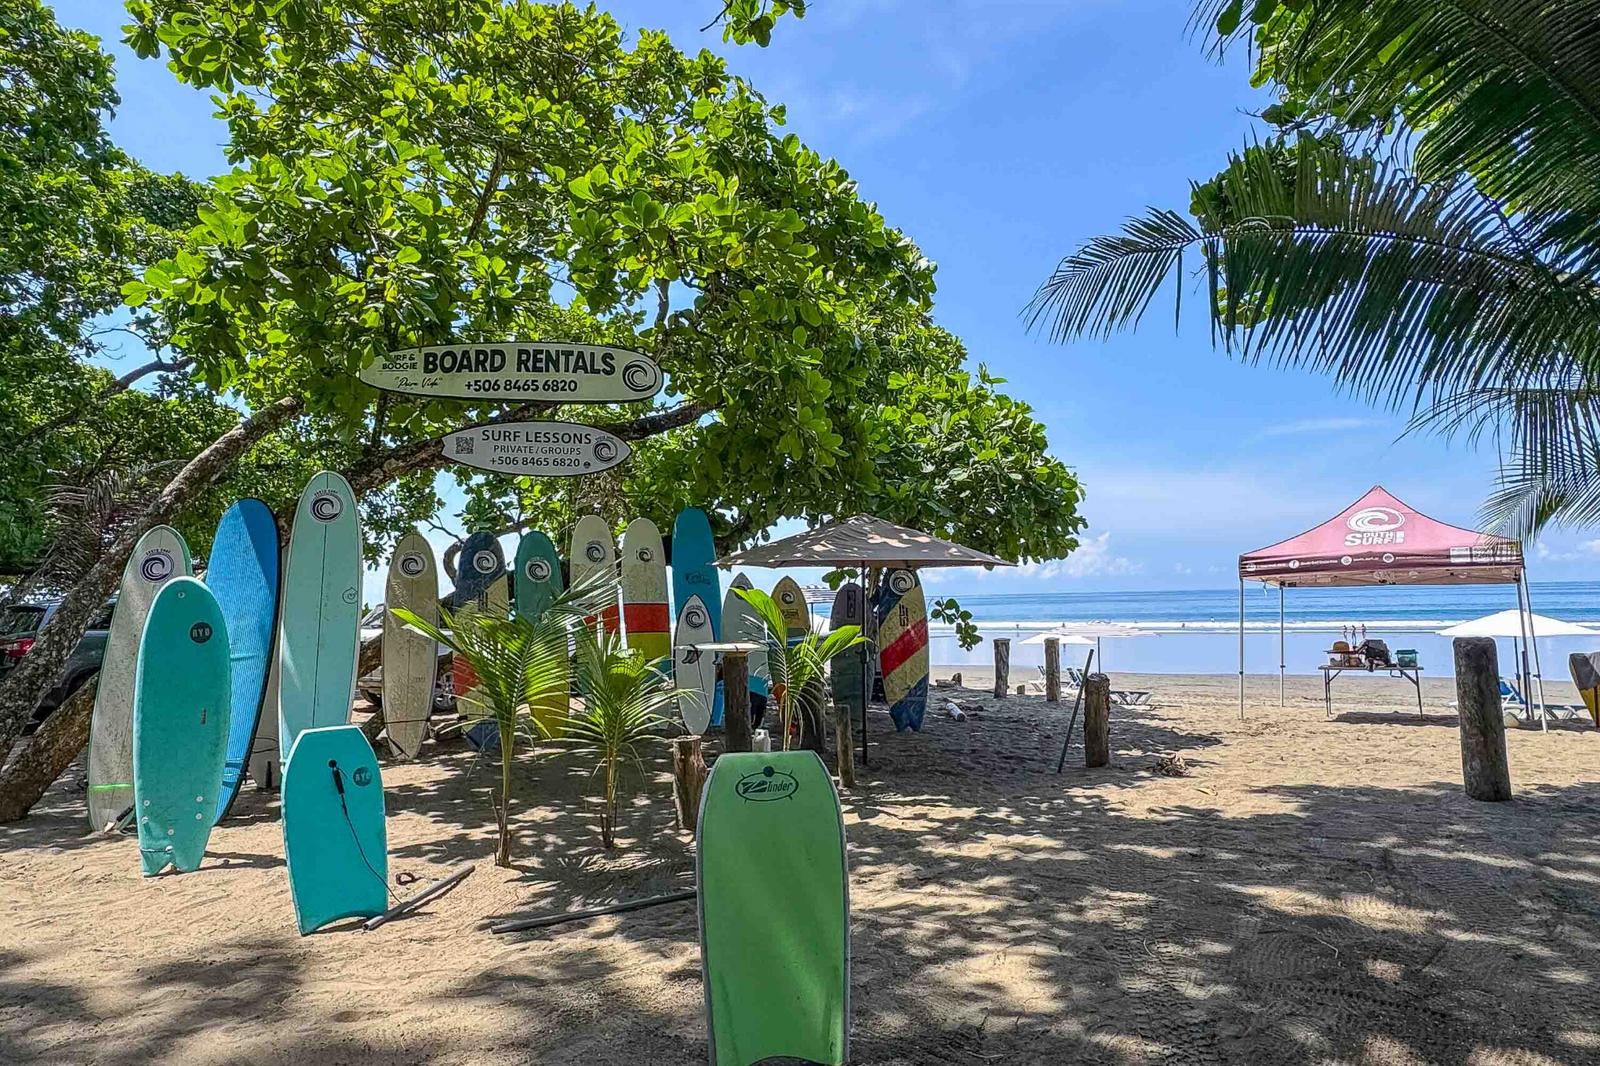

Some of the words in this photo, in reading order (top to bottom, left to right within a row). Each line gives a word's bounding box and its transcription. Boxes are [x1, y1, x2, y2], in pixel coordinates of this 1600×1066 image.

[408, 353, 416, 361] &
[423, 349, 507, 374] BOARD
[516, 348, 616, 376] RENTALS
[382, 361, 418, 370] BOOGIE
[465, 379, 500, 392] +506
[503, 379, 539, 392] 8465
[542, 379, 578, 392] 6820
[481, 429, 521, 442] SURF
[525, 431, 592, 444] LESSONS
[489, 456, 519, 466] +506
[521, 456, 550, 466] 8465
[552, 457, 580, 467] 6820
[1344, 533, 1393, 546] SURF
